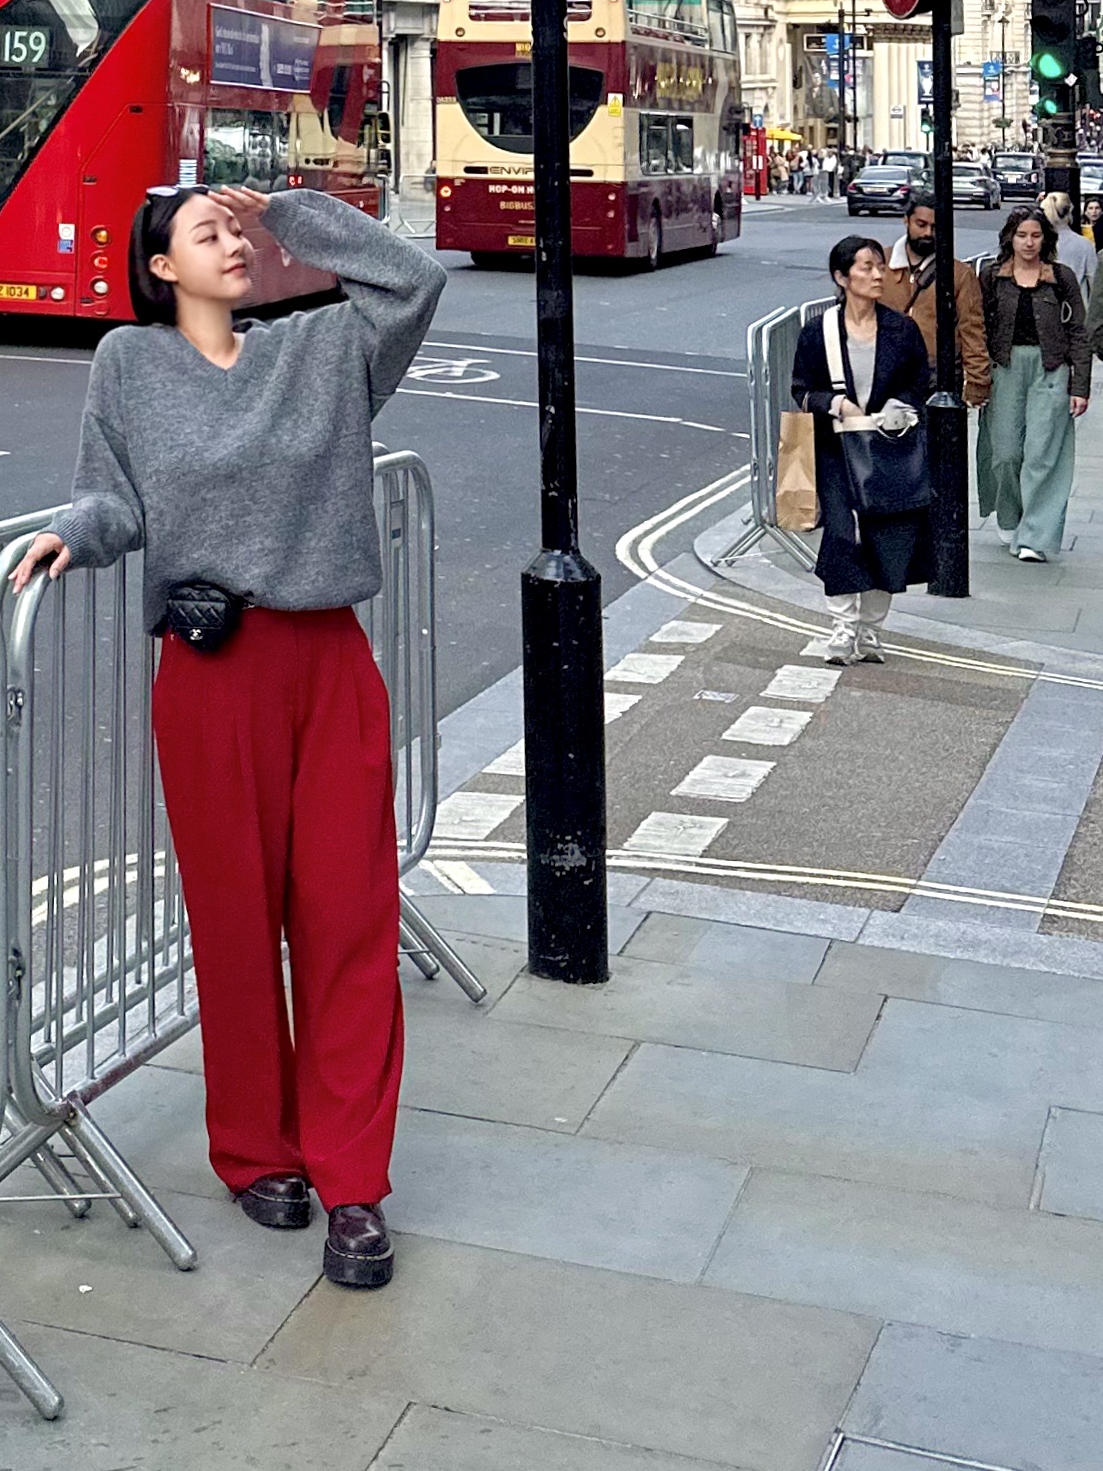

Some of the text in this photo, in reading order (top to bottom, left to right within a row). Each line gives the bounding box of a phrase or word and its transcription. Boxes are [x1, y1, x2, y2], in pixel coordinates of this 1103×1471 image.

[3, 30, 47, 63] 159
[488, 184, 525, 194] HOP-ON
[6, 286, 30, 297] 1034
